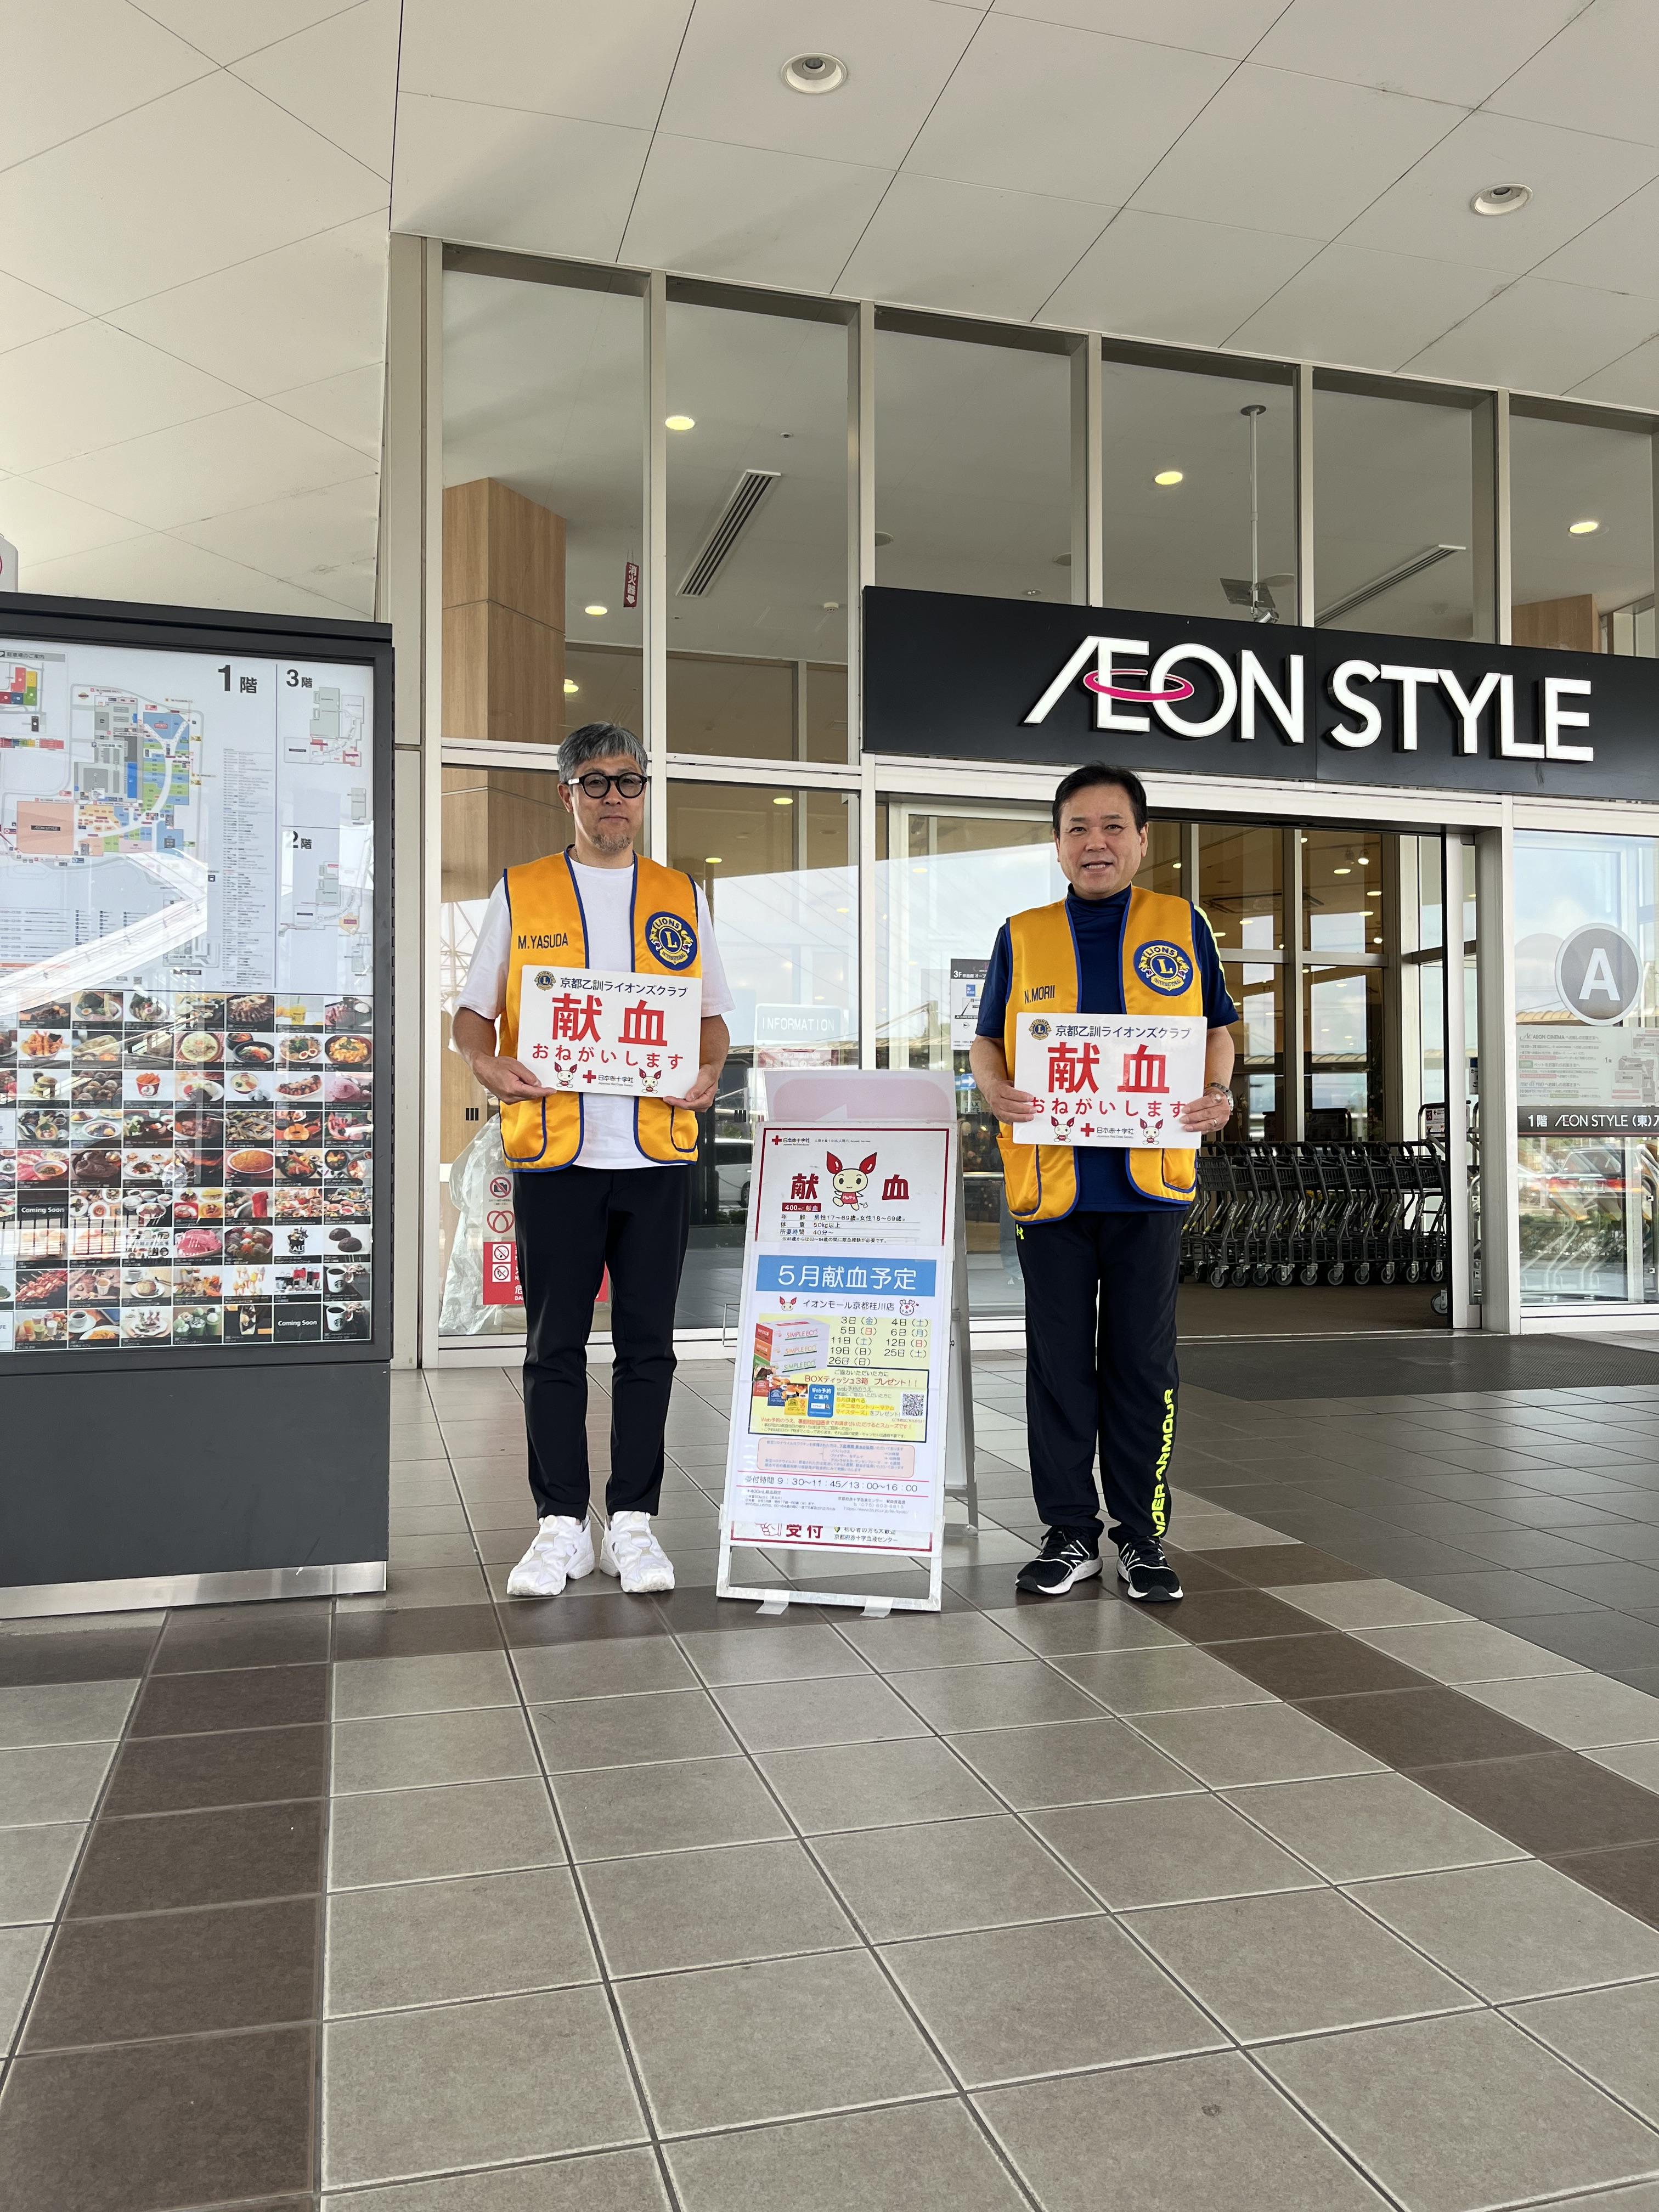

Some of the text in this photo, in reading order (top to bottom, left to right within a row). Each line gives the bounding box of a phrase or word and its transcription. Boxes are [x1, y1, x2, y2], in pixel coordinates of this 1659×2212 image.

[628, 564, 637, 596] 消火器
[217, 664, 257, 693] 1階
[286, 669, 313, 688] 3階
[1329, 659, 1595, 762] STYLE
[654, 918, 680, 929] LIONS
[517, 933, 568, 950] M.YASUDA
[664, 931, 678, 948] L
[1146, 947, 1175, 956] LIONS
[1157, 958, 1173, 974] L
[1578, 948, 1621, 1001] A
[560, 977, 689, 997] 京都乙訓ライオンズクラブ
[552, 993, 668, 1047] 献血
[763, 1018, 834, 1031] INFORMATION
[1055, 1025, 1192, 1040] 京都乙訓ライオンズクラブ
[532, 1043, 683, 1069] おねがいします
[1047, 1041, 1170, 1094] 献血
[598, 1074, 634, 1084] 日本赤十字社
[1528, 1114, 1548, 1127] 1階
[1591, 1114, 1628, 1127] STYLE
[777, 1264, 917, 1291] 5月献血予定
[802, 1300, 895, 1311] イオンモール京都桂川店
[786, 1330, 805, 1339] SIMPLE
[805, 1375, 868, 1385] BOXティッシュ3箱
[1155, 1388, 1174, 1481] ARMOUR
[745, 1475, 774, 1485] 受付時間
[834, 1534, 899, 1543] 京都府赤十字血液センター
[844, 1527, 896, 1535] 初心者の方も大歓迎
